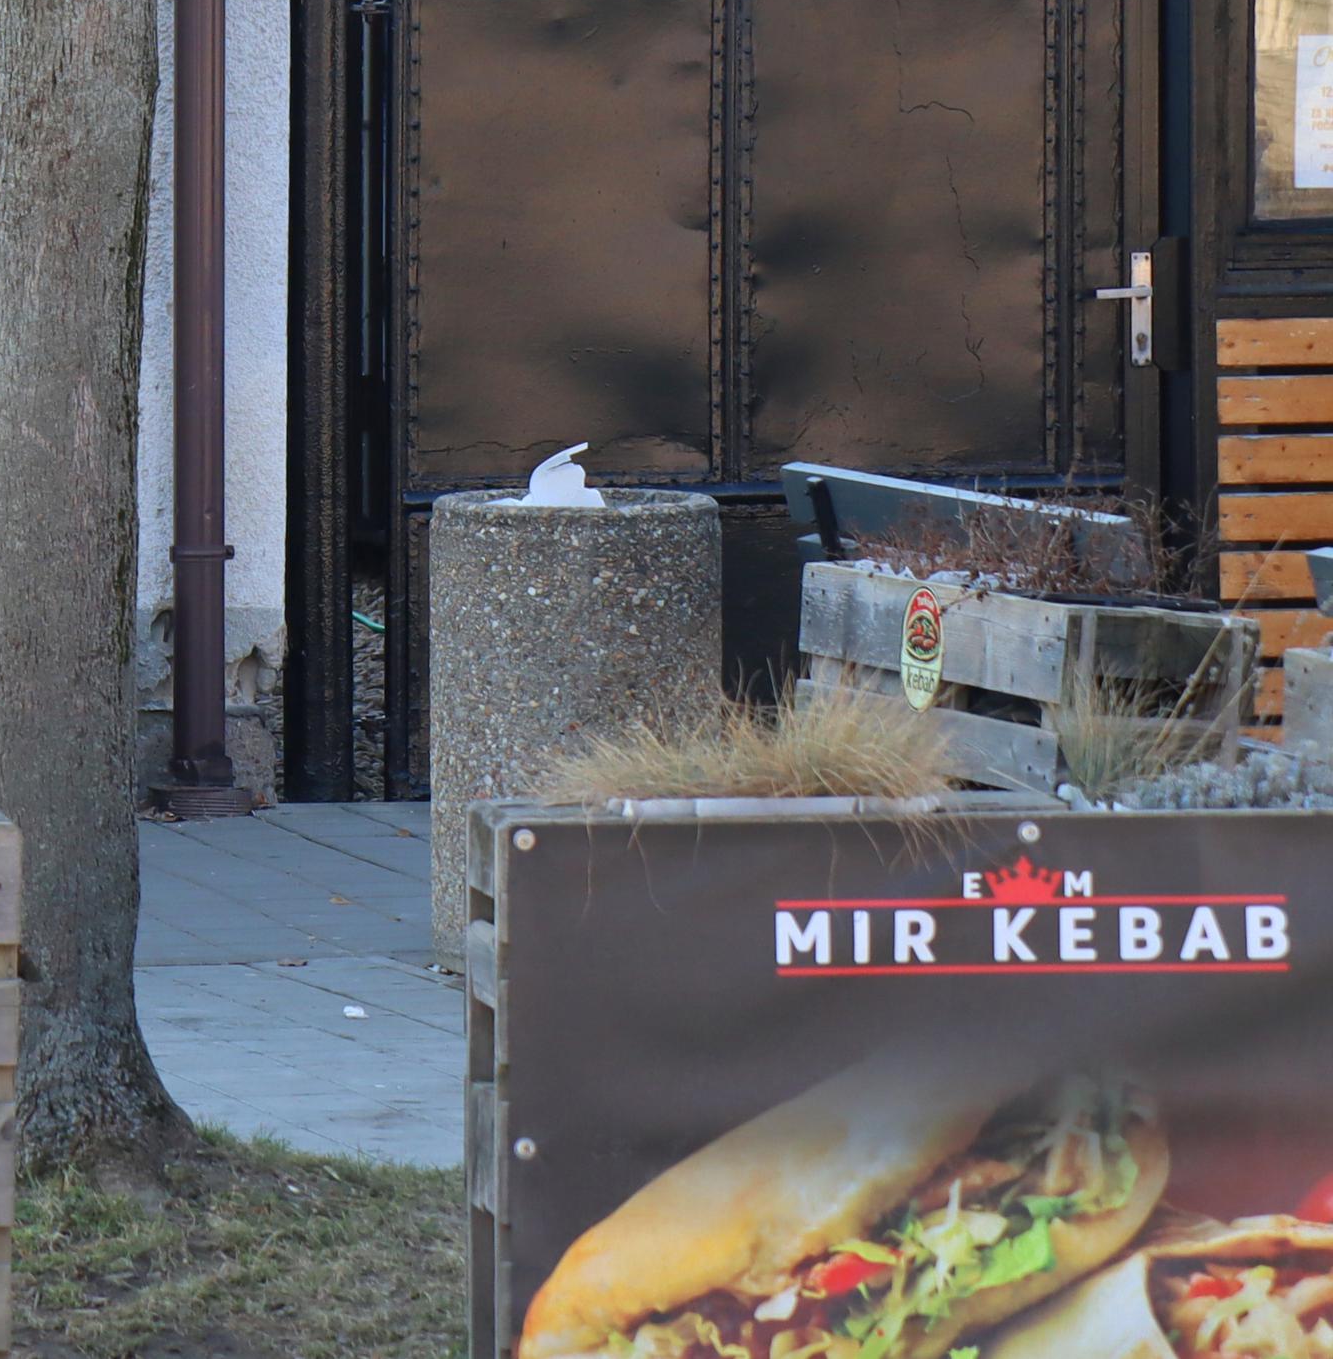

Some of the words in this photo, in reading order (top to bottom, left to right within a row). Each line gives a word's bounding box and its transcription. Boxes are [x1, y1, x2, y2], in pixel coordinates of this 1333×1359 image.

[963, 872, 981, 898] E
[1064, 871, 1092, 897] M
[993, 905, 1289, 962] KEBAB
